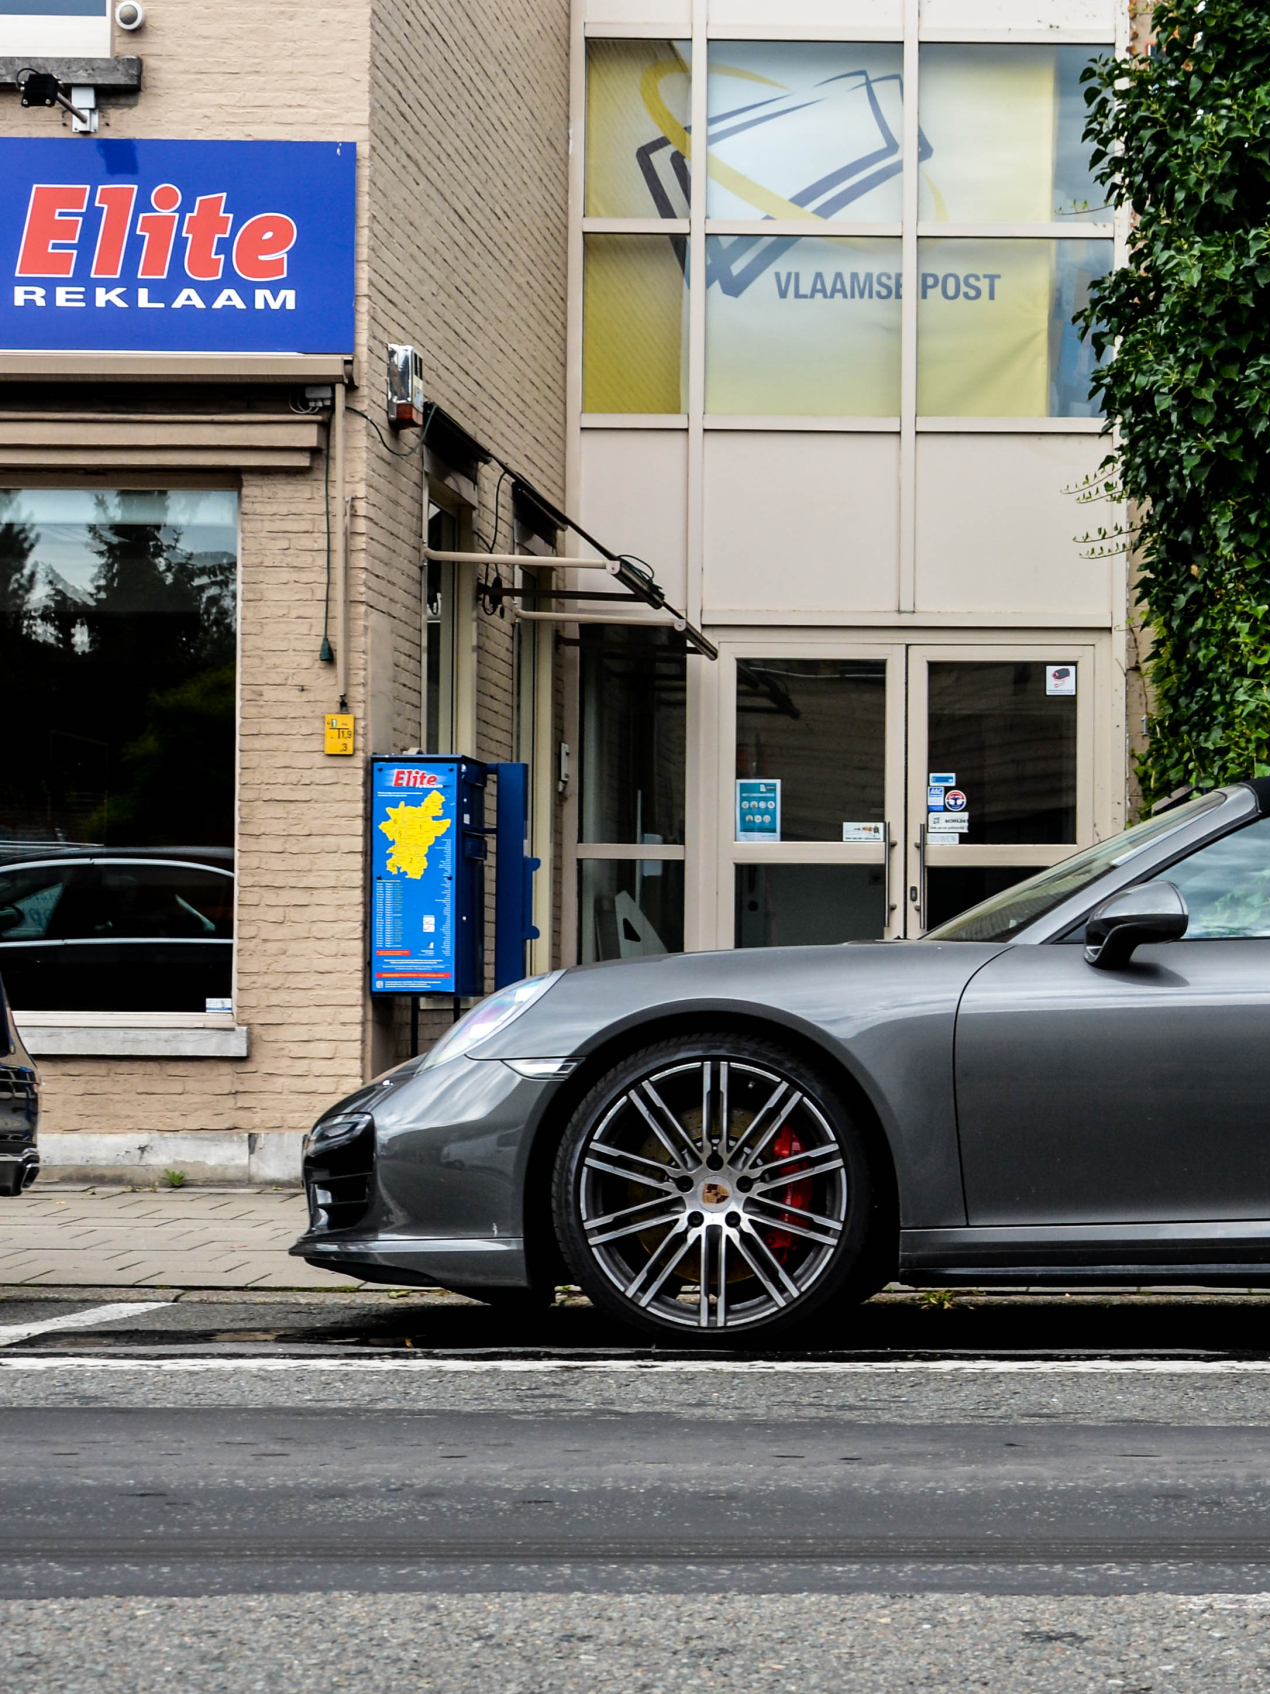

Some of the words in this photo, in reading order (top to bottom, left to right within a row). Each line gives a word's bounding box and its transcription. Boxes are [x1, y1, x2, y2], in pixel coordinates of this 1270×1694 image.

[15, 183, 297, 282] Elite
[14, 285, 296, 310] REKLAAM
[921, 272, 1002, 301] POST
[392, 768, 438, 788] Elite
